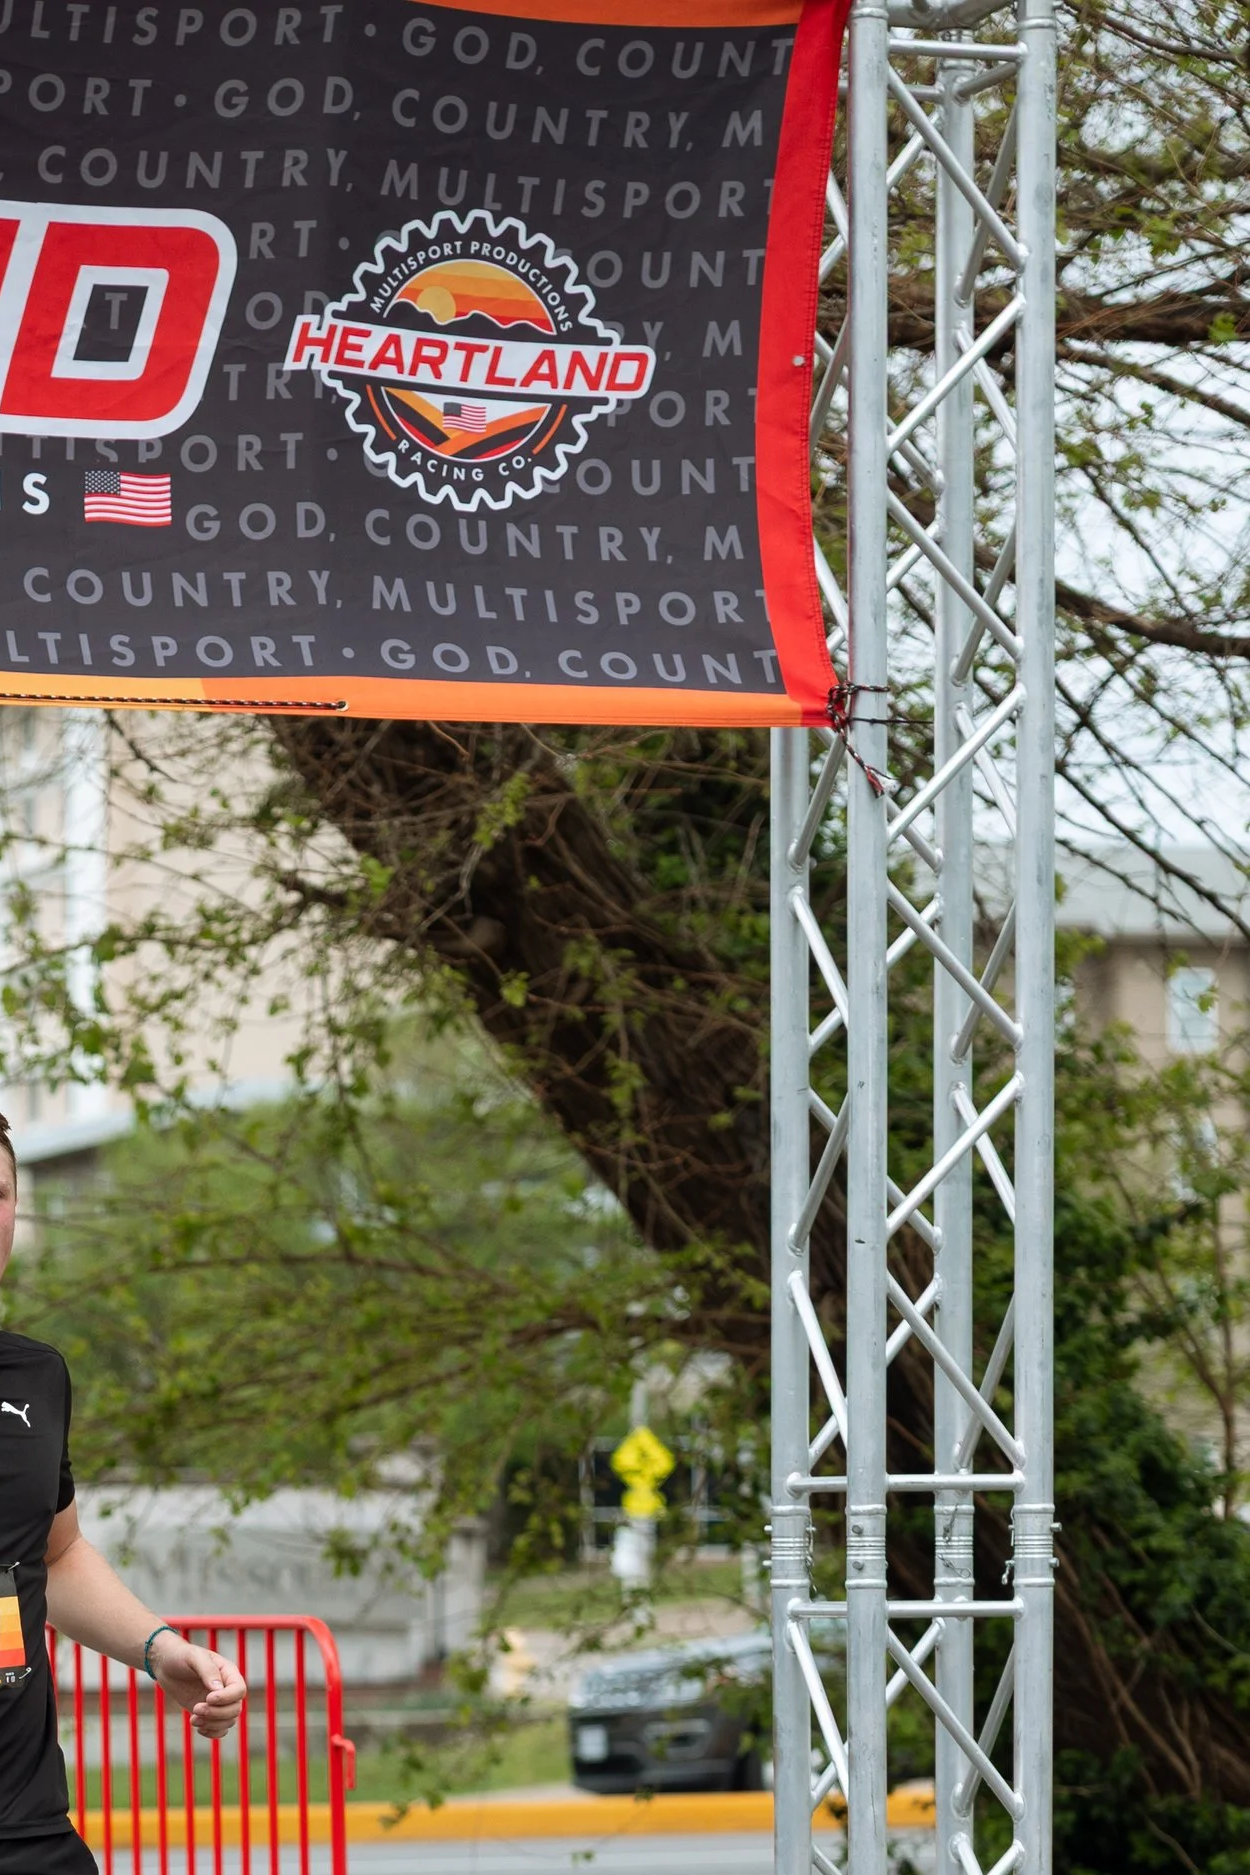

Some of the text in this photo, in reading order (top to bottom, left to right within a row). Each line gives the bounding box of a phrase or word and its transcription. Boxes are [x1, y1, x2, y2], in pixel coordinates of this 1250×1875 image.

[403, 18, 547, 75] GOD,
[577, 38, 794, 79] COUNT
[214, 76, 361, 121] GOD,
[392, 89, 693, 151] COUNTRY,
[38, 146, 353, 192] COUNTRY,
[369, 240, 462, 313] MULTISPORT
[470, 241, 572, 332] PRODUCTIONS
[291, 320, 650, 392] HEARTLAND
[398, 438, 484, 481] RACING
[498, 457, 532, 476] CO.
[541, 457, 755, 495] OUNT
[186, 502, 336, 542] GOD,
[365, 509, 672, 564] COUNTRY,
[24, 567, 342, 609] COUNTRY,
[558, 650, 778, 684] COUNT
